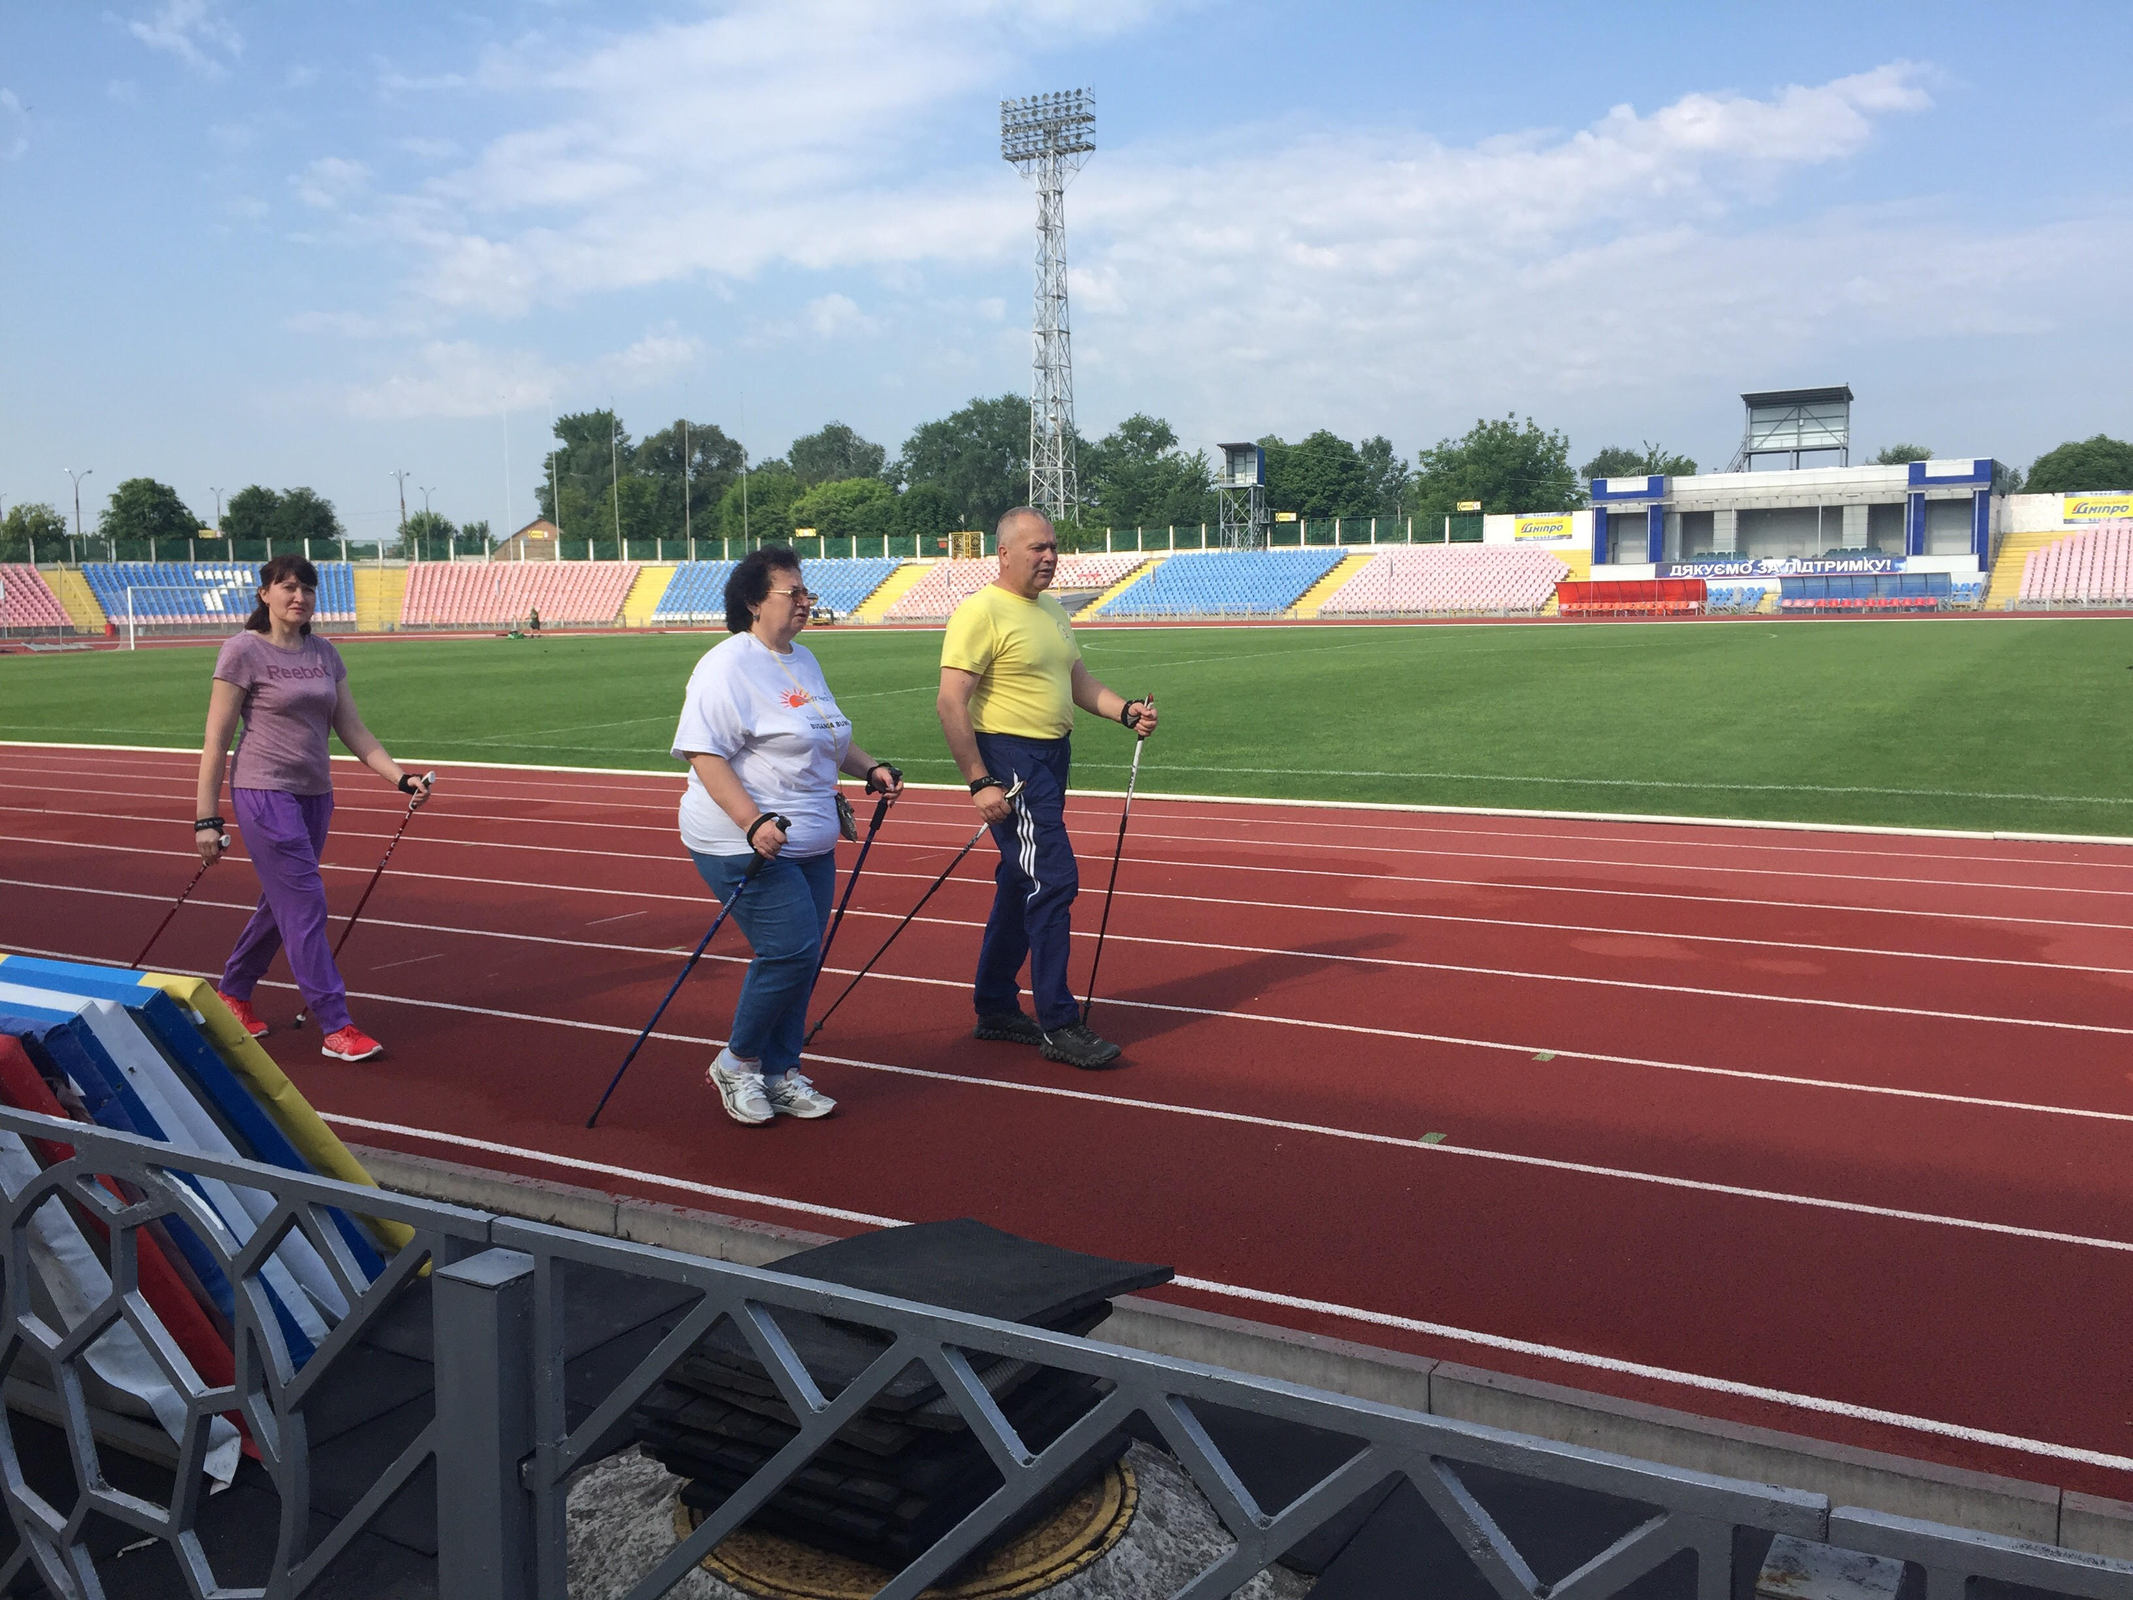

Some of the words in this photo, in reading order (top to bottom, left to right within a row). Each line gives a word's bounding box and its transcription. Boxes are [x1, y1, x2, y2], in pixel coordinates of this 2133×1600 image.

[1669, 563, 1753, 577] ДЯКУЄМО
[1757, 562, 1780, 574] ЗА
[1784, 558, 1892, 575] ПІДТРИМКУ!
